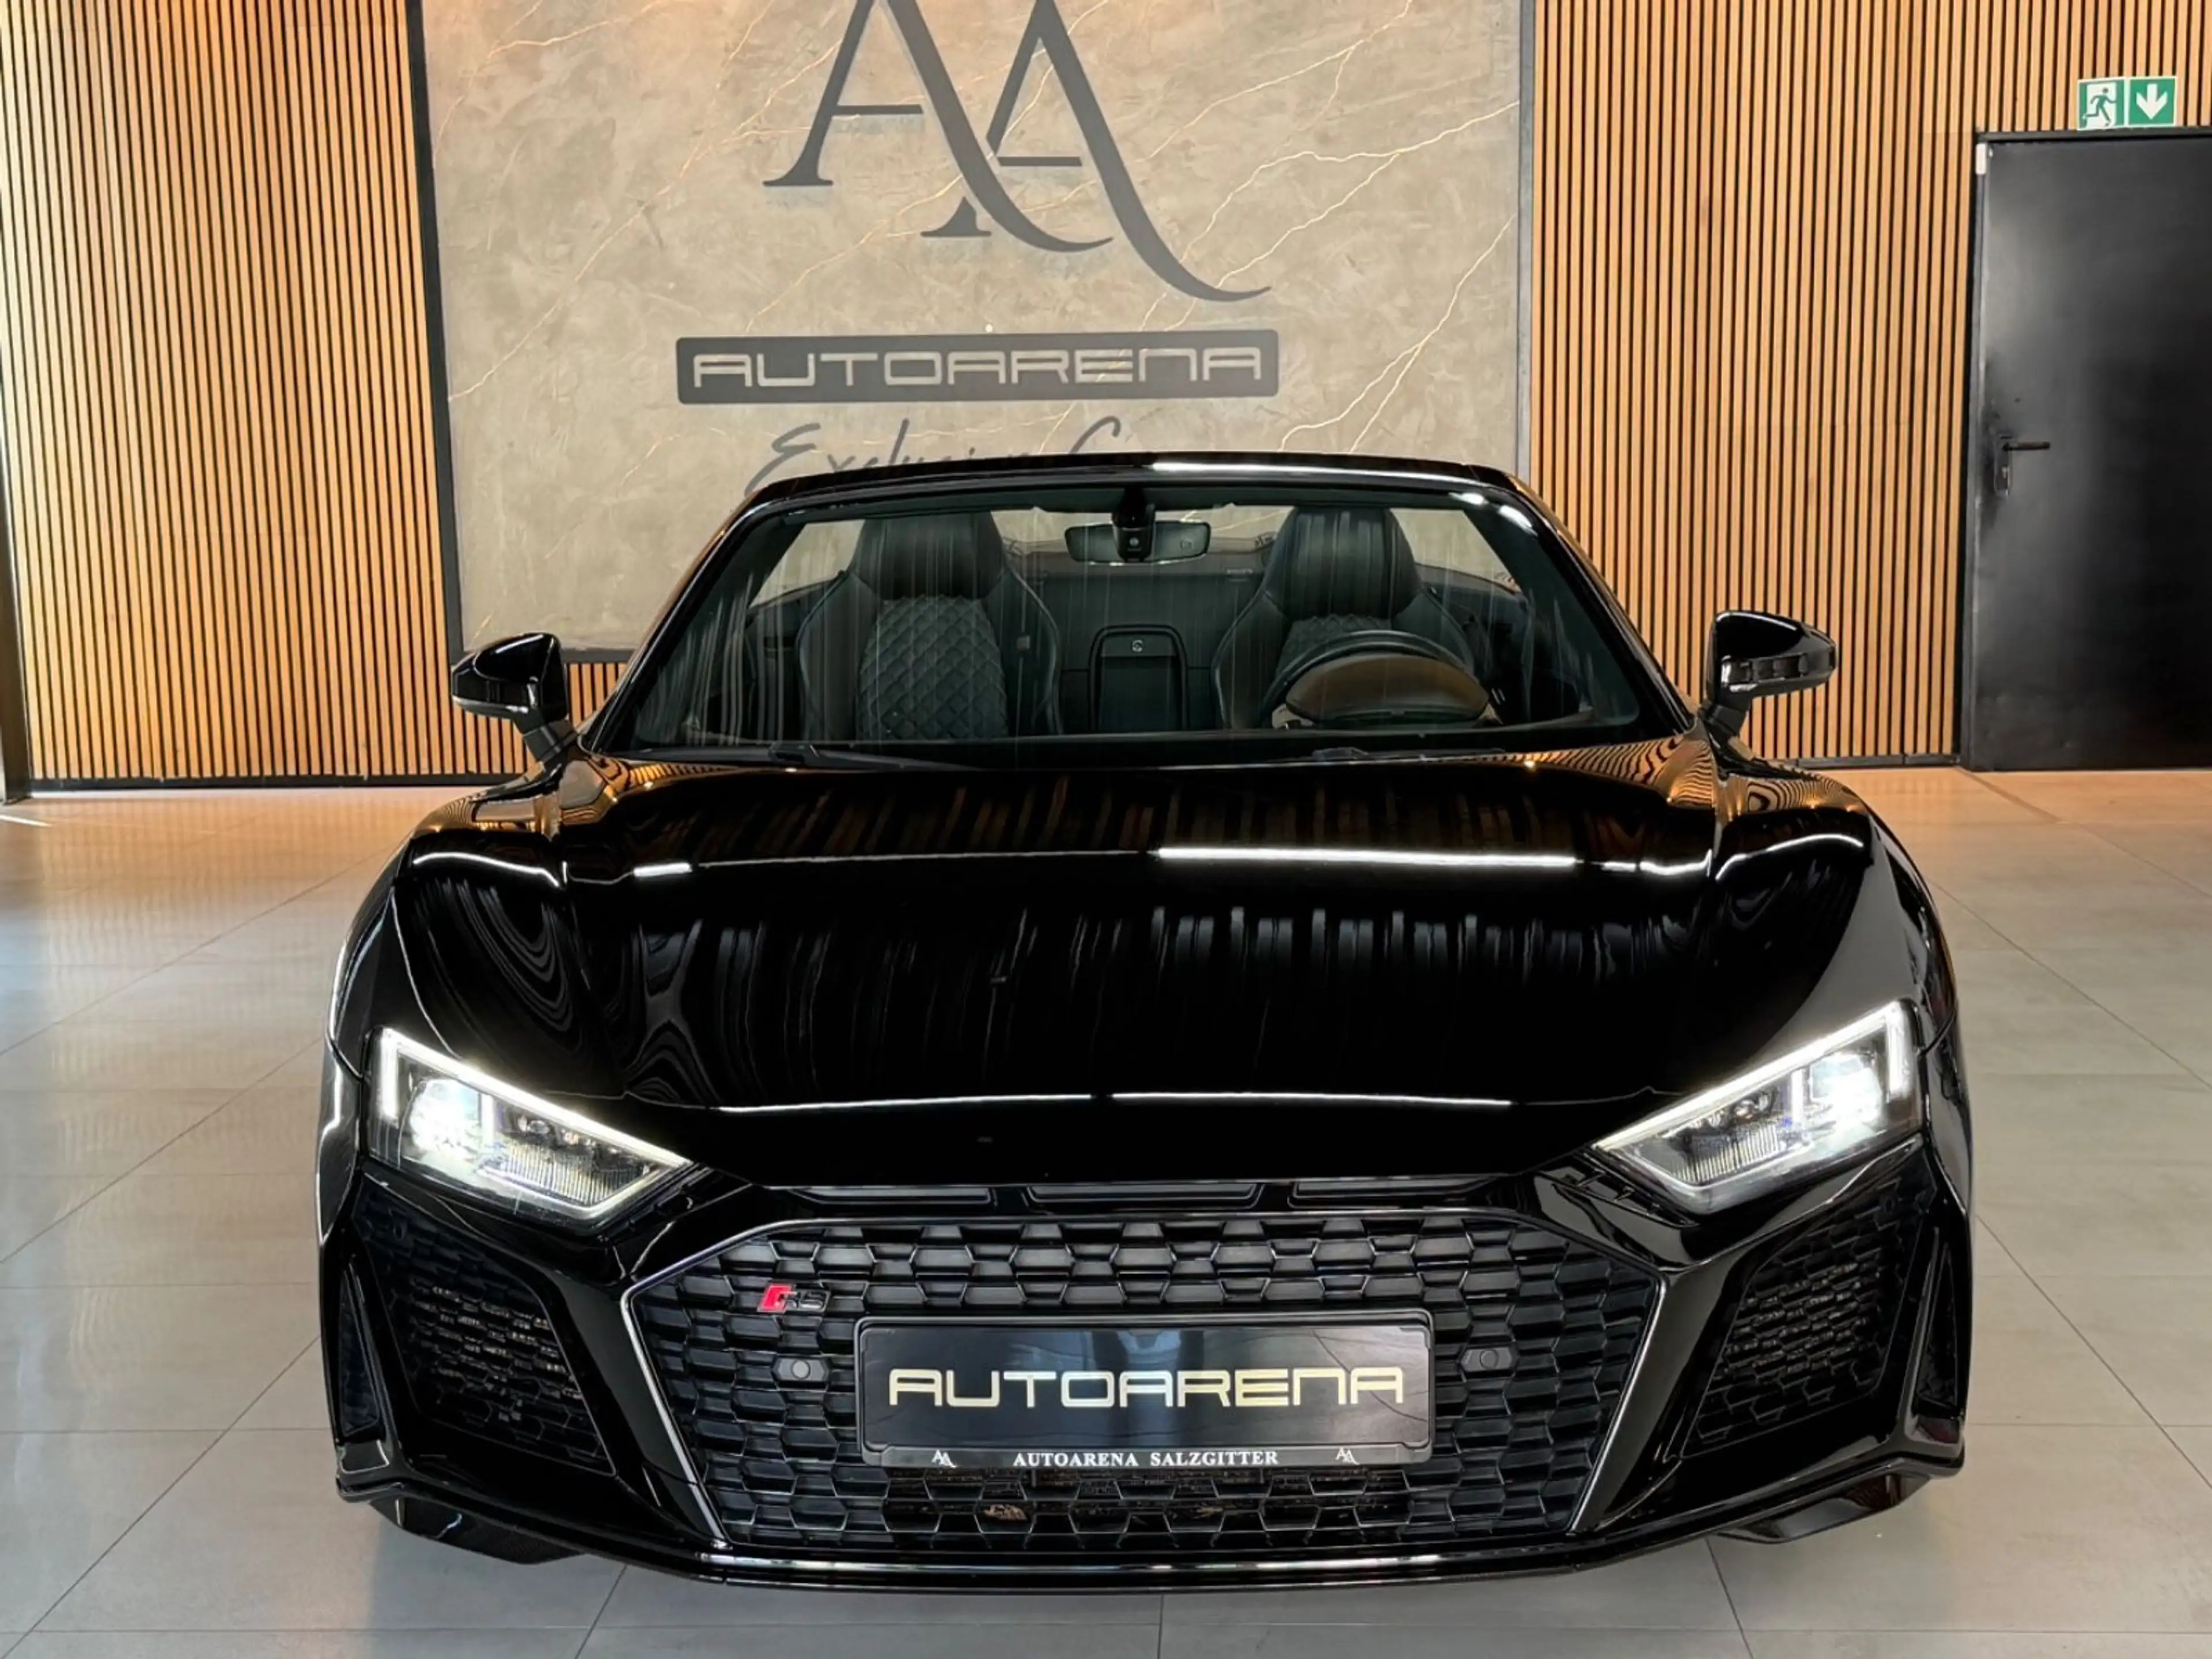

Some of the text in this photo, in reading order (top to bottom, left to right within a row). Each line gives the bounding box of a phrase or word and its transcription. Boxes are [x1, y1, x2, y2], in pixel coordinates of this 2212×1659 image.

[693, 347, 1262, 388] AUTOARENA
[889, 1367, 1403, 1407] AUTOARENA
[1013, 1452, 1139, 1467] AUTOARENA
[1150, 1450, 1278, 1467] SALZGITTER
